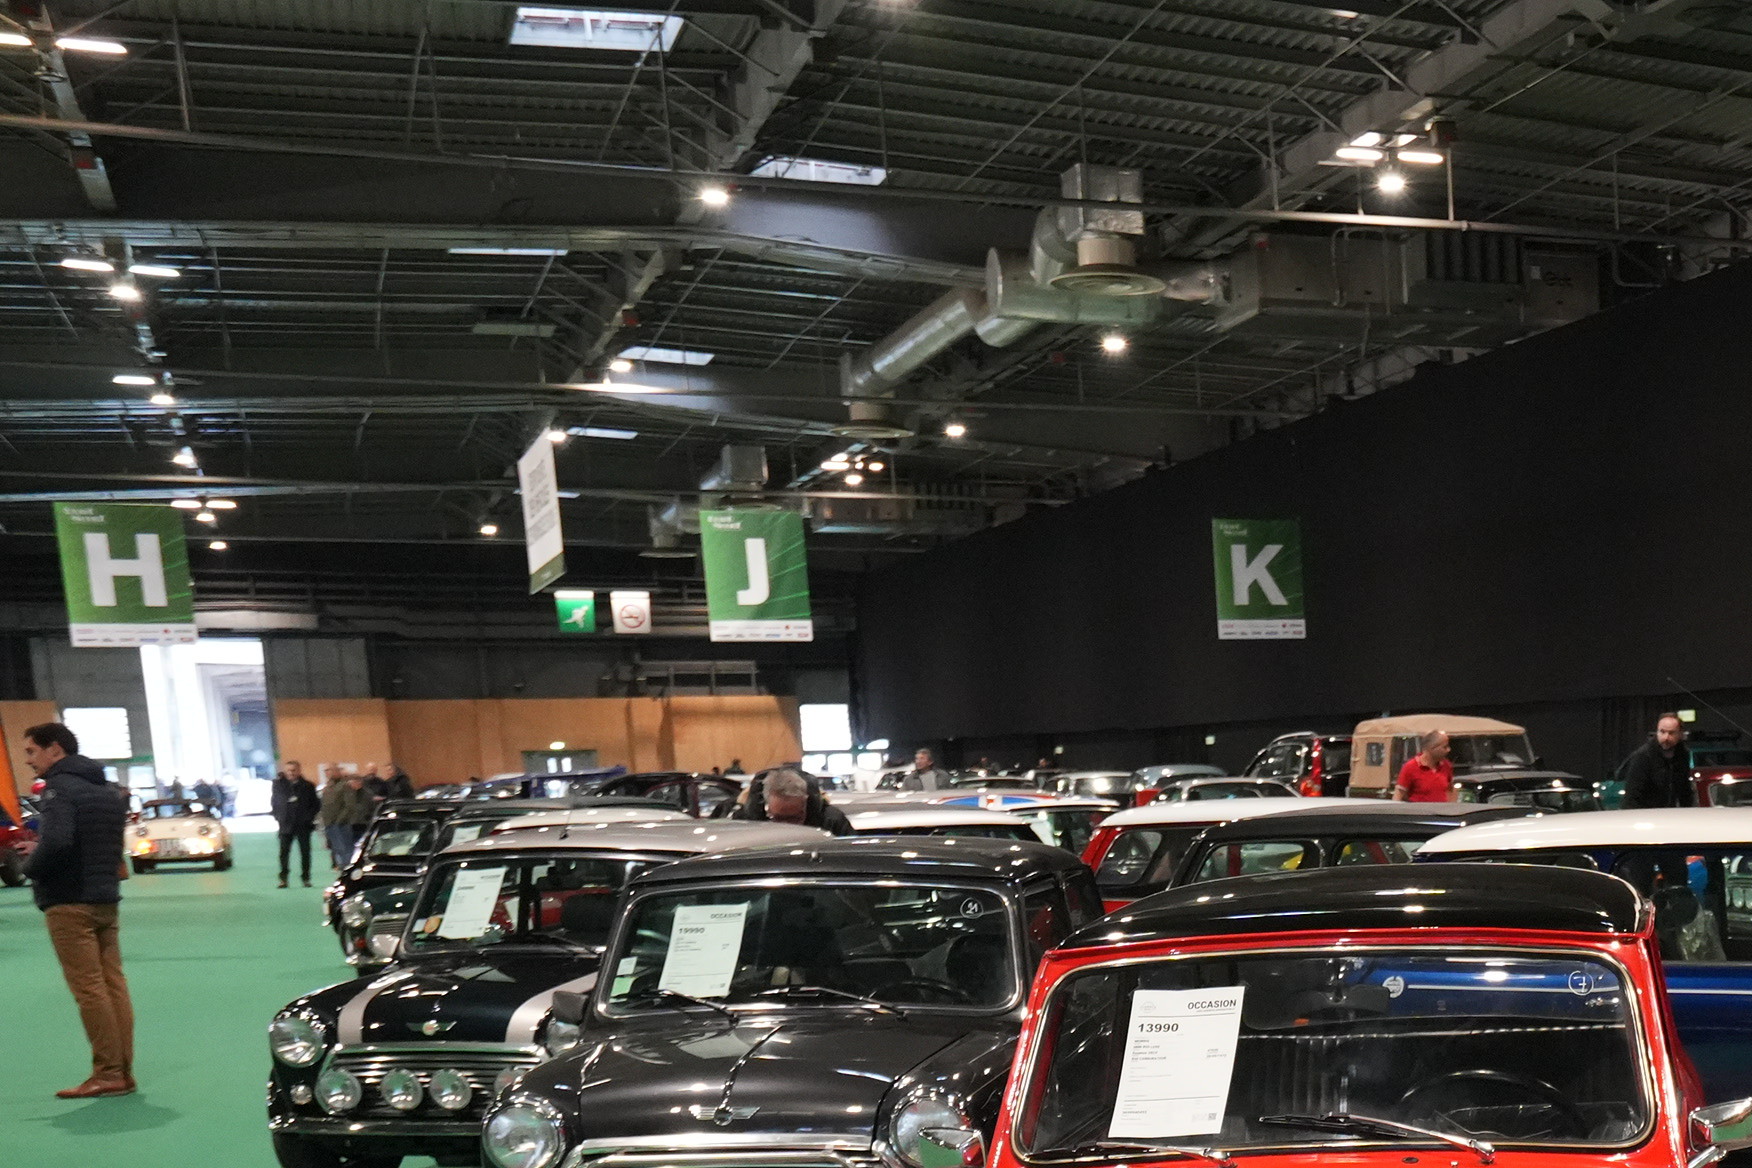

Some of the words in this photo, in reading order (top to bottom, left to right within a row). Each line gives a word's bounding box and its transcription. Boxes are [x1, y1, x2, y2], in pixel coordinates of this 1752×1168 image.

[83, 532, 169, 607] H
[736, 537, 770, 606] J
[1230, 544, 1289, 606] K
[1138, 1023, 1179, 1033] 13990
[1187, 999, 1237, 1010] OCCASION
